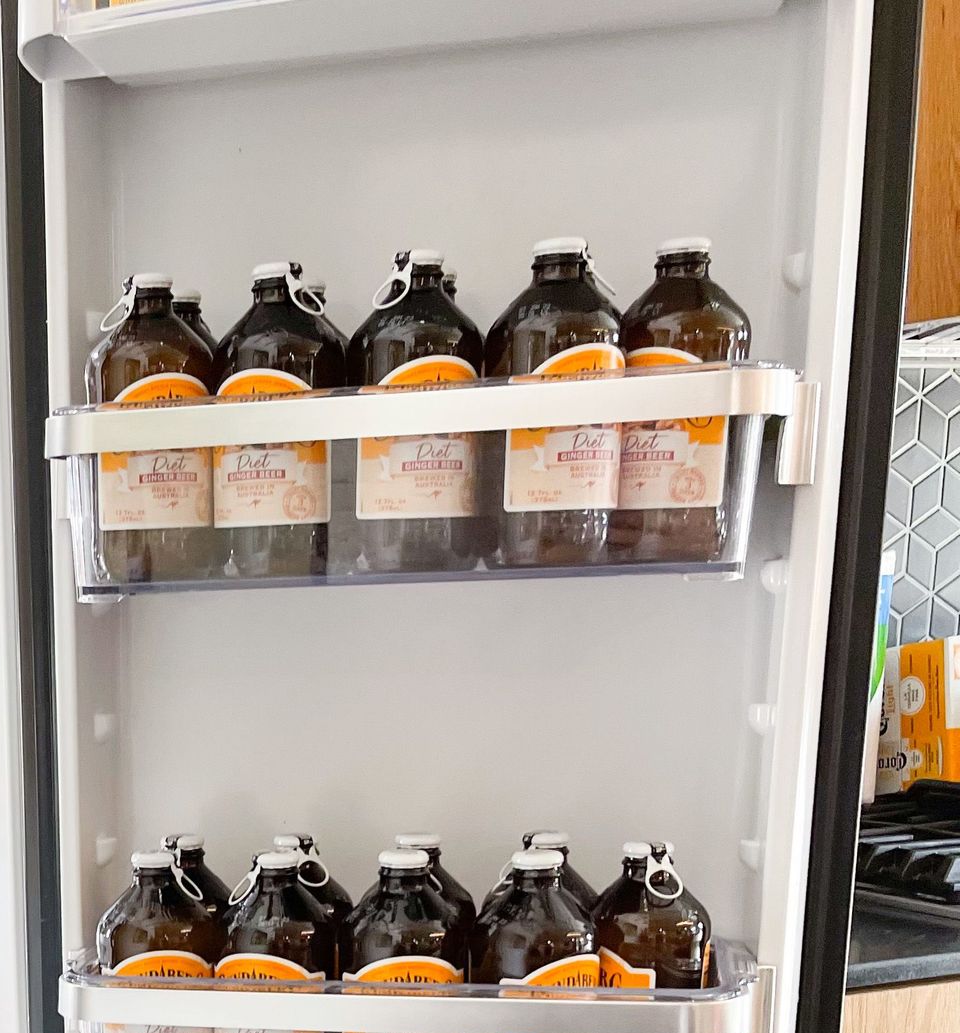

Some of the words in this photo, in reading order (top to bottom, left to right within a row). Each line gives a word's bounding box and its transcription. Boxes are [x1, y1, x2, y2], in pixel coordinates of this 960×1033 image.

[572, 432, 606, 450] Diet
[624, 432, 661, 450] Diet
[416, 441, 453, 460] Diet
[560, 452, 593, 462] GINGER
[622, 452, 644, 462] NGER
[646, 451, 671, 461] BEER
[153, 454, 187, 473] Diet
[236, 453, 271, 471] Diet
[404, 461, 439, 471] GINGER
[440, 460, 461, 470] BEER
[142, 473, 174, 483] GINGER
[176, 472, 197, 482] BEER
[229, 471, 258, 482] GINGER
[259, 470, 284, 480] BEER
